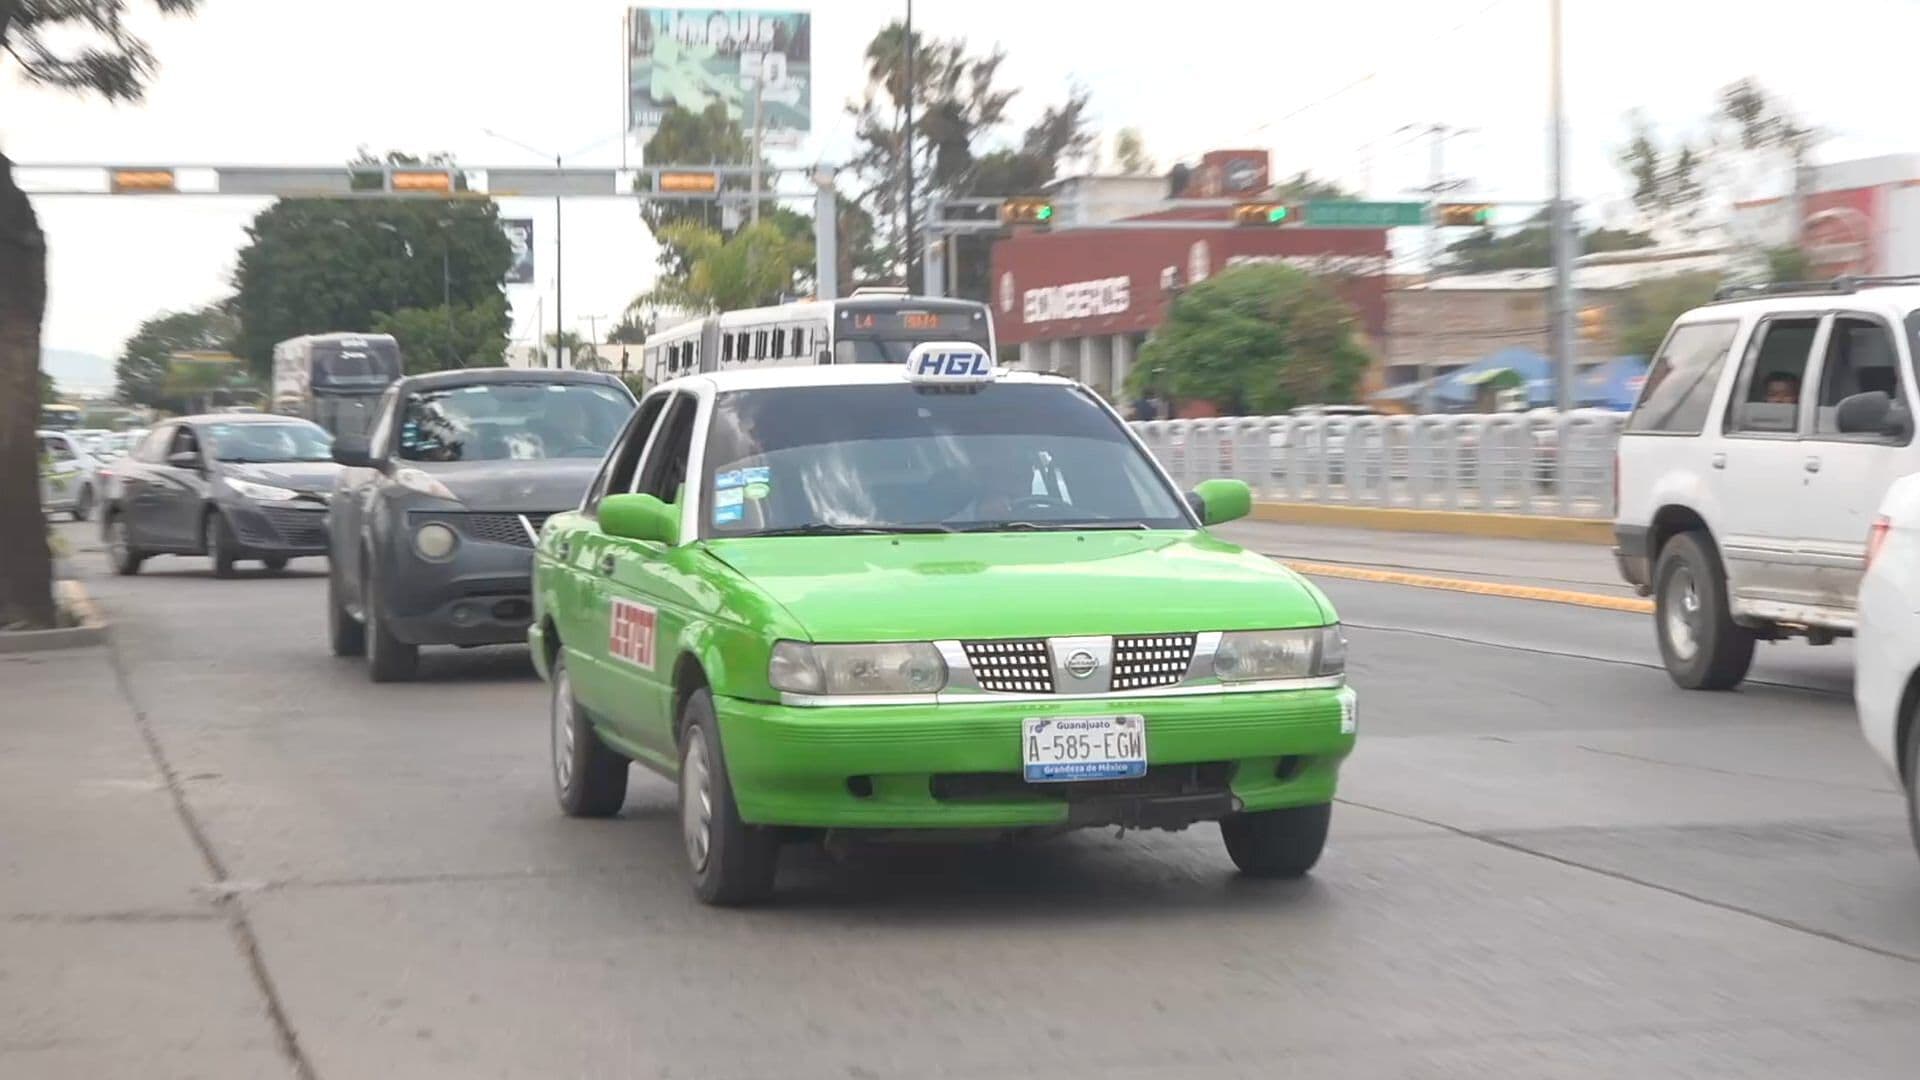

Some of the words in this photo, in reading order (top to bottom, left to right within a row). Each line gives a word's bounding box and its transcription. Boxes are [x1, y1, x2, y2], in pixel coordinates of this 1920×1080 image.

[1023, 275, 1131, 324] BOMBEROS
[918, 353, 988, 375] HGL
[1056, 720, 1110, 731] Guanajuato
[1029, 731, 1141, 762] A-585-EGW
[1043, 764, 1084, 774] Grandeza
[1086, 764, 1096, 773] de
